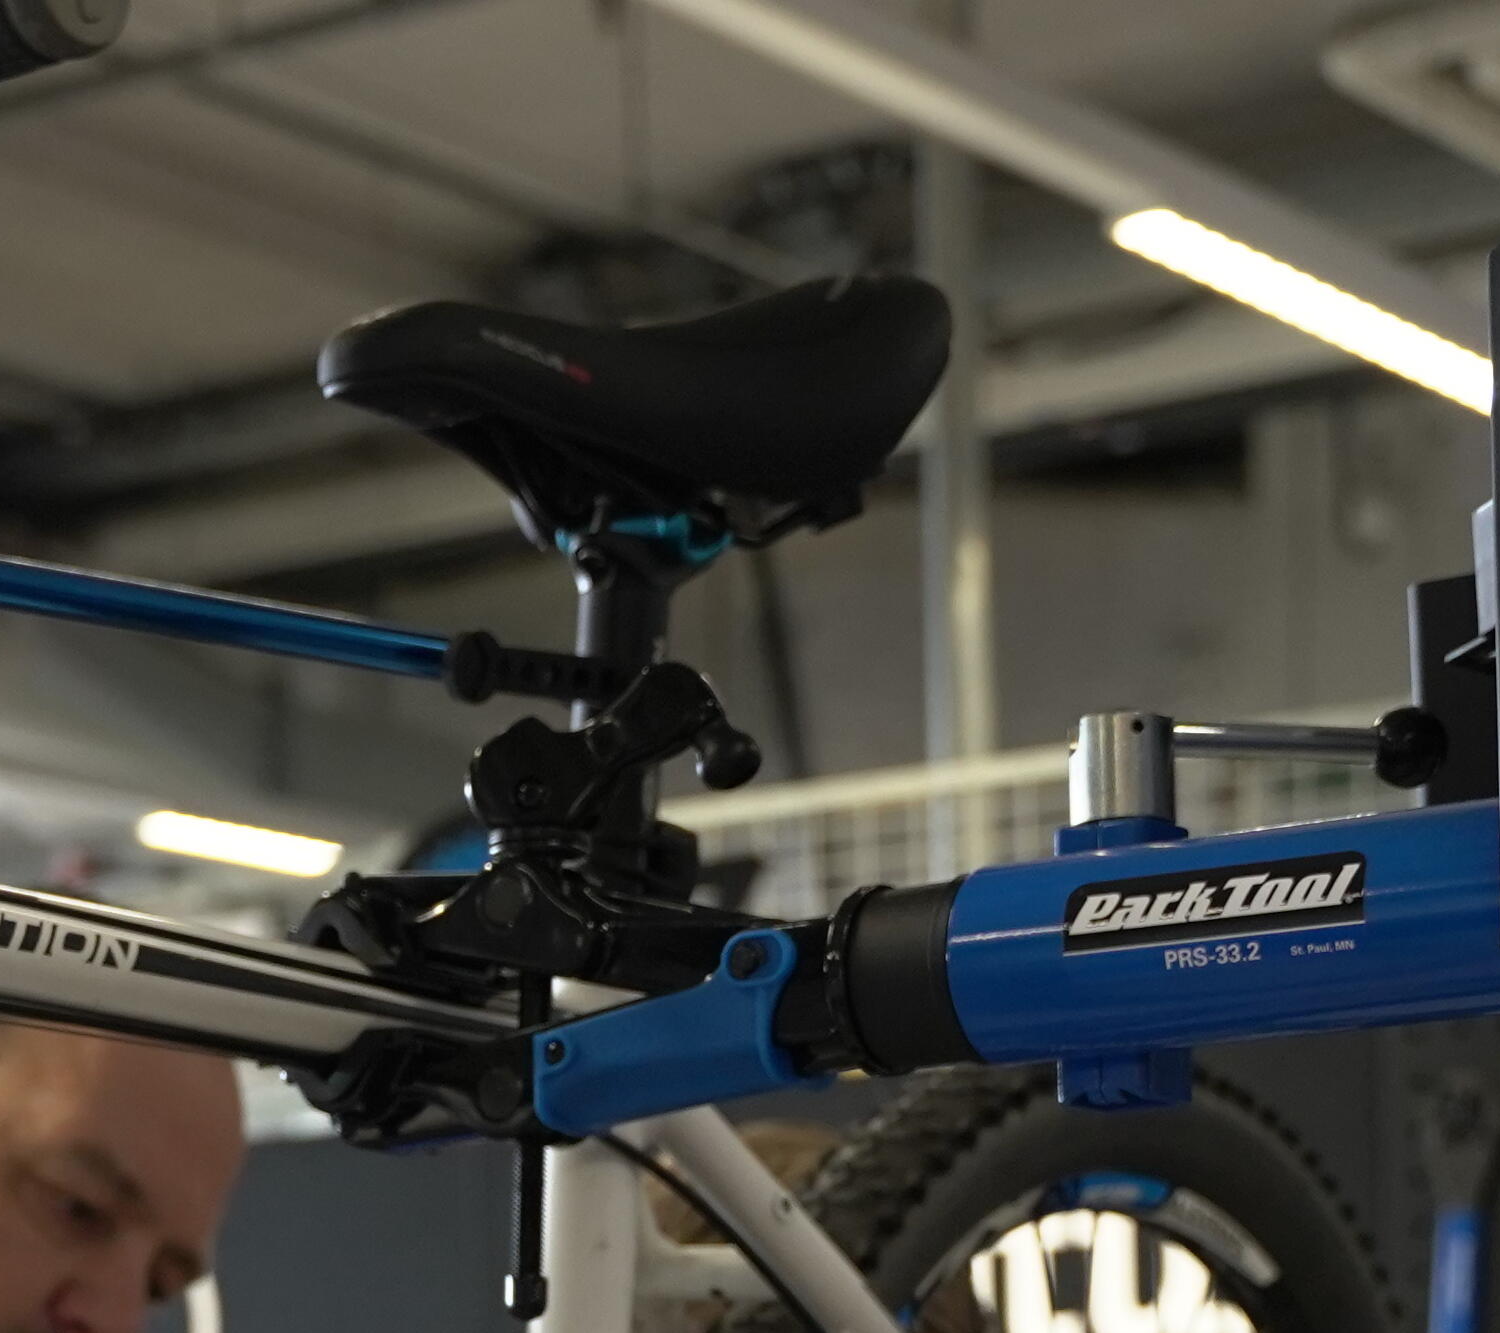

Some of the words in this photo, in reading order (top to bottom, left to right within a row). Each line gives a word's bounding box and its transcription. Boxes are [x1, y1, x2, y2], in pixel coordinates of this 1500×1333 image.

[1068, 880, 1223, 936] Park
[1219, 862, 1361, 917] Tool
[1163, 941, 1262, 971] PRS-33.2
[1334, 940, 1354, 952] MN
